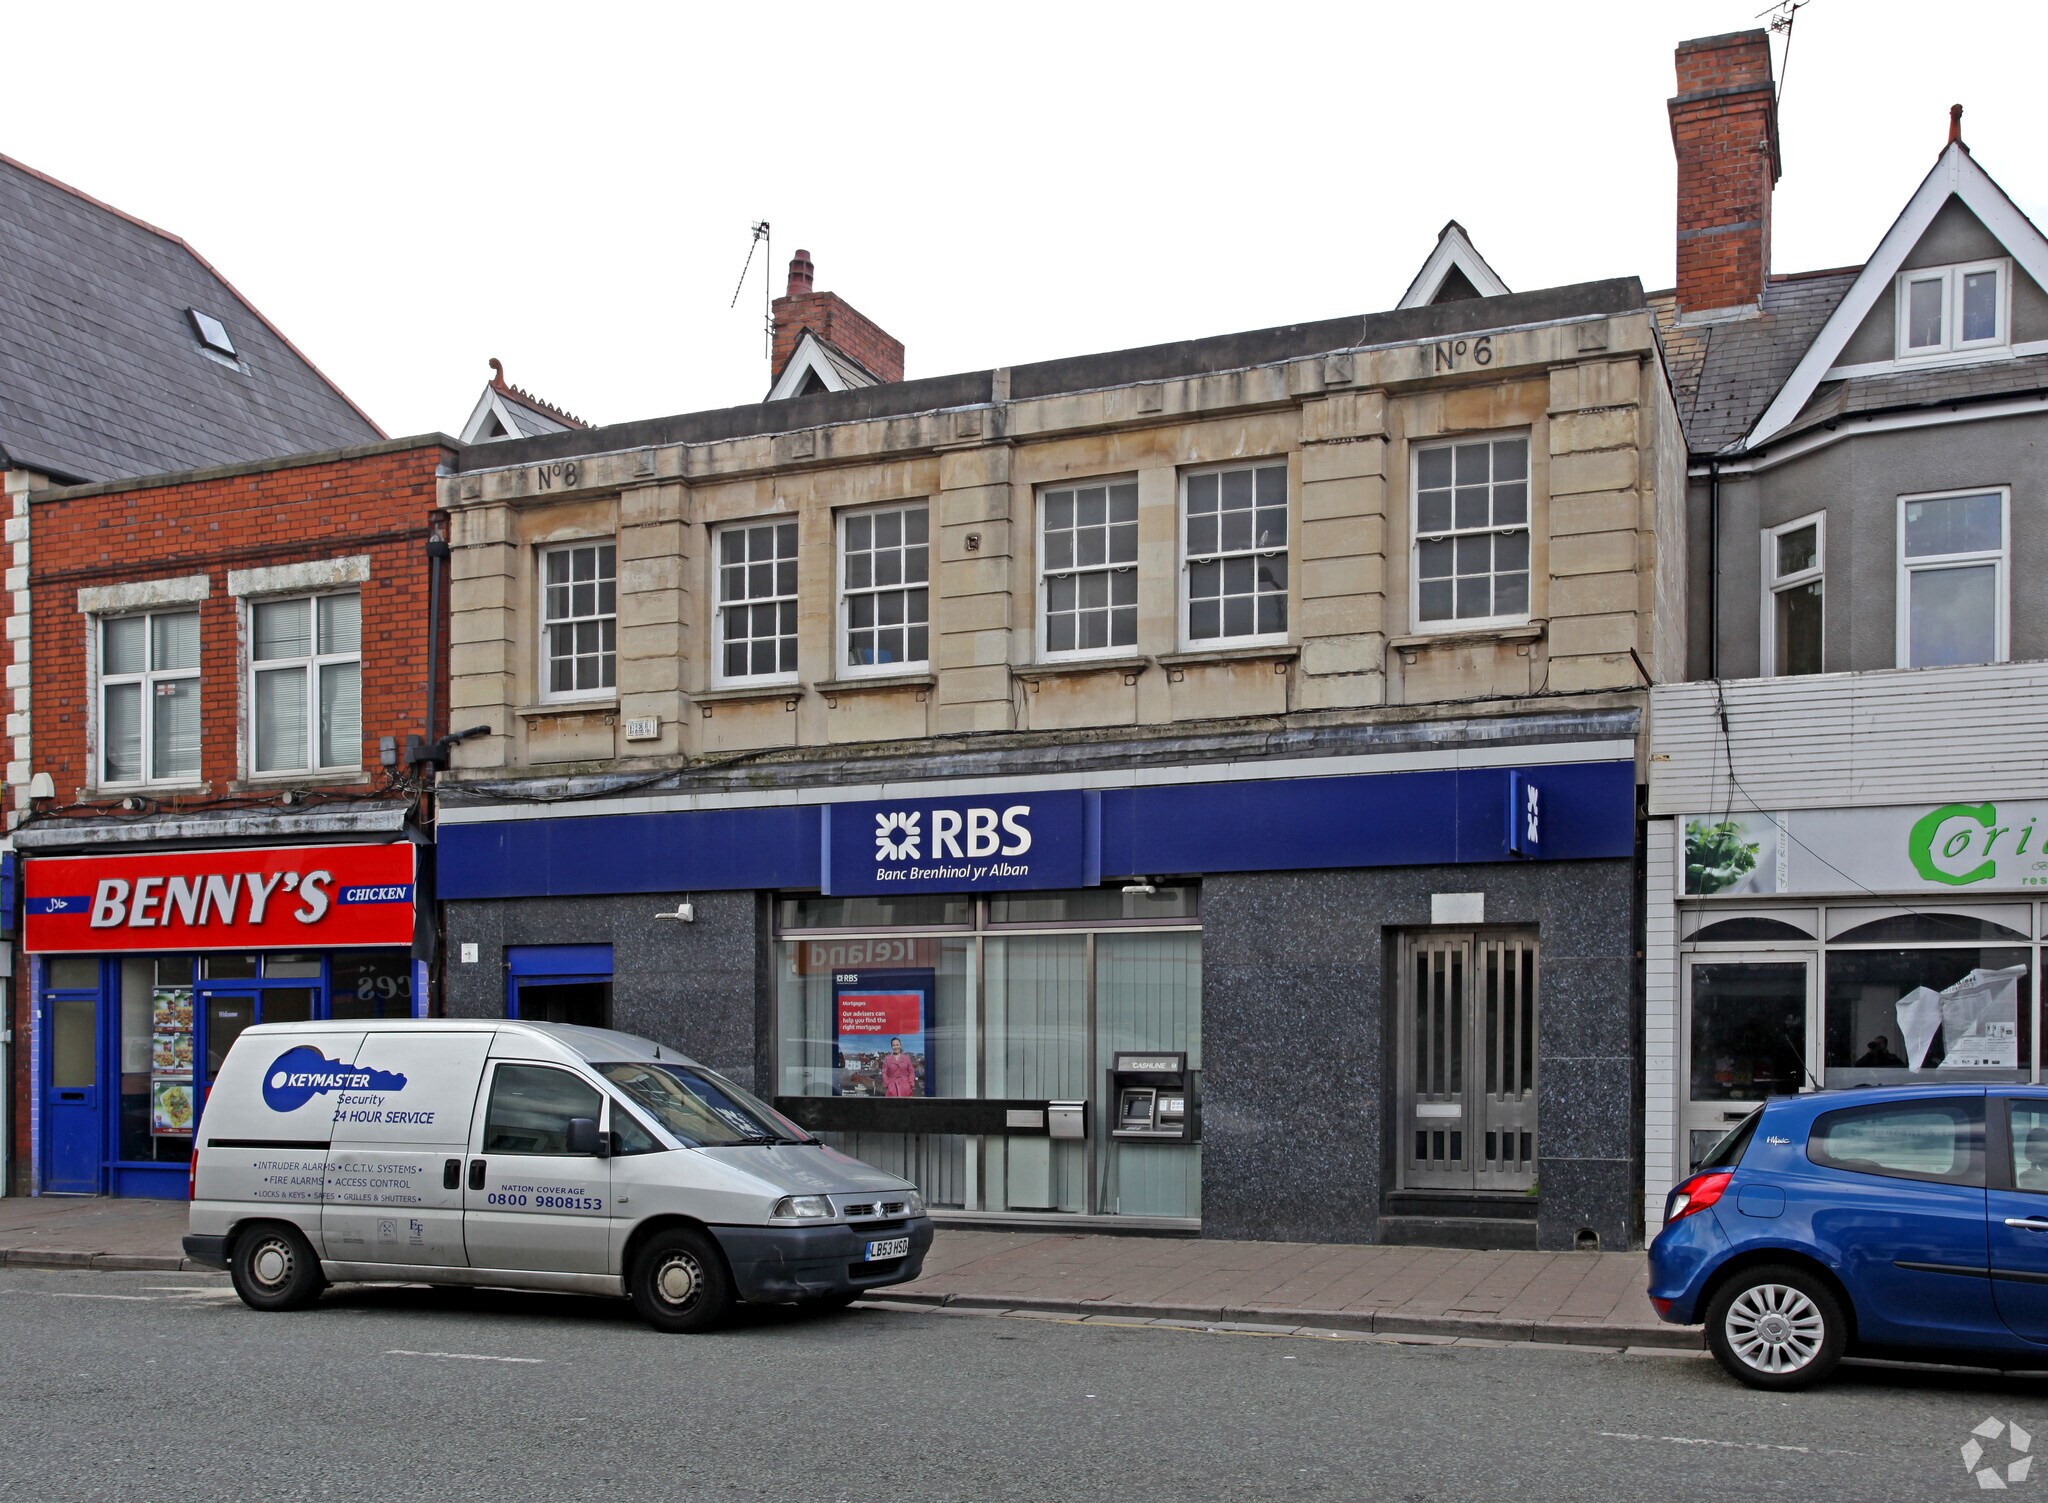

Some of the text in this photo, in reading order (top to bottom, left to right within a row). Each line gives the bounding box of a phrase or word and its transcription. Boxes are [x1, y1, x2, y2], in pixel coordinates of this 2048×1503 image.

[931, 805, 1032, 860] RBS
[876, 862, 1029, 882] Banc Brenhinol yr Alban
[89, 869, 334, 928] BENNY'S
[346, 886, 407, 902] CHICKEN
[844, 974, 858, 982] RBS
[287, 1073, 371, 1088] KEYMASTER
[336, 1094, 385, 1107] Security
[332, 1110, 435, 1124] 24 HOUR SERVICE
[258, 1161, 417, 1174] INTRUDER ALARMS C.C.T.V. SYSTEMS
[269, 1176, 411, 1188] FIRE ALARMS ACCESS CONTROL
[258, 1190, 280, 1198] LOCKS
[288, 1191, 306, 1199] KEYS
[313, 1192, 335, 1200] SAFES
[343, 1193, 371, 1201] GRILLES
[373, 1194, 379, 1202] &
[381, 1194, 417, 1203] SHUTTERS
[501, 1184, 585, 1195] NATION COVERAGE
[487, 1193, 603, 1210] 0800 9808153
[870, 1241, 892, 1258] LB53
